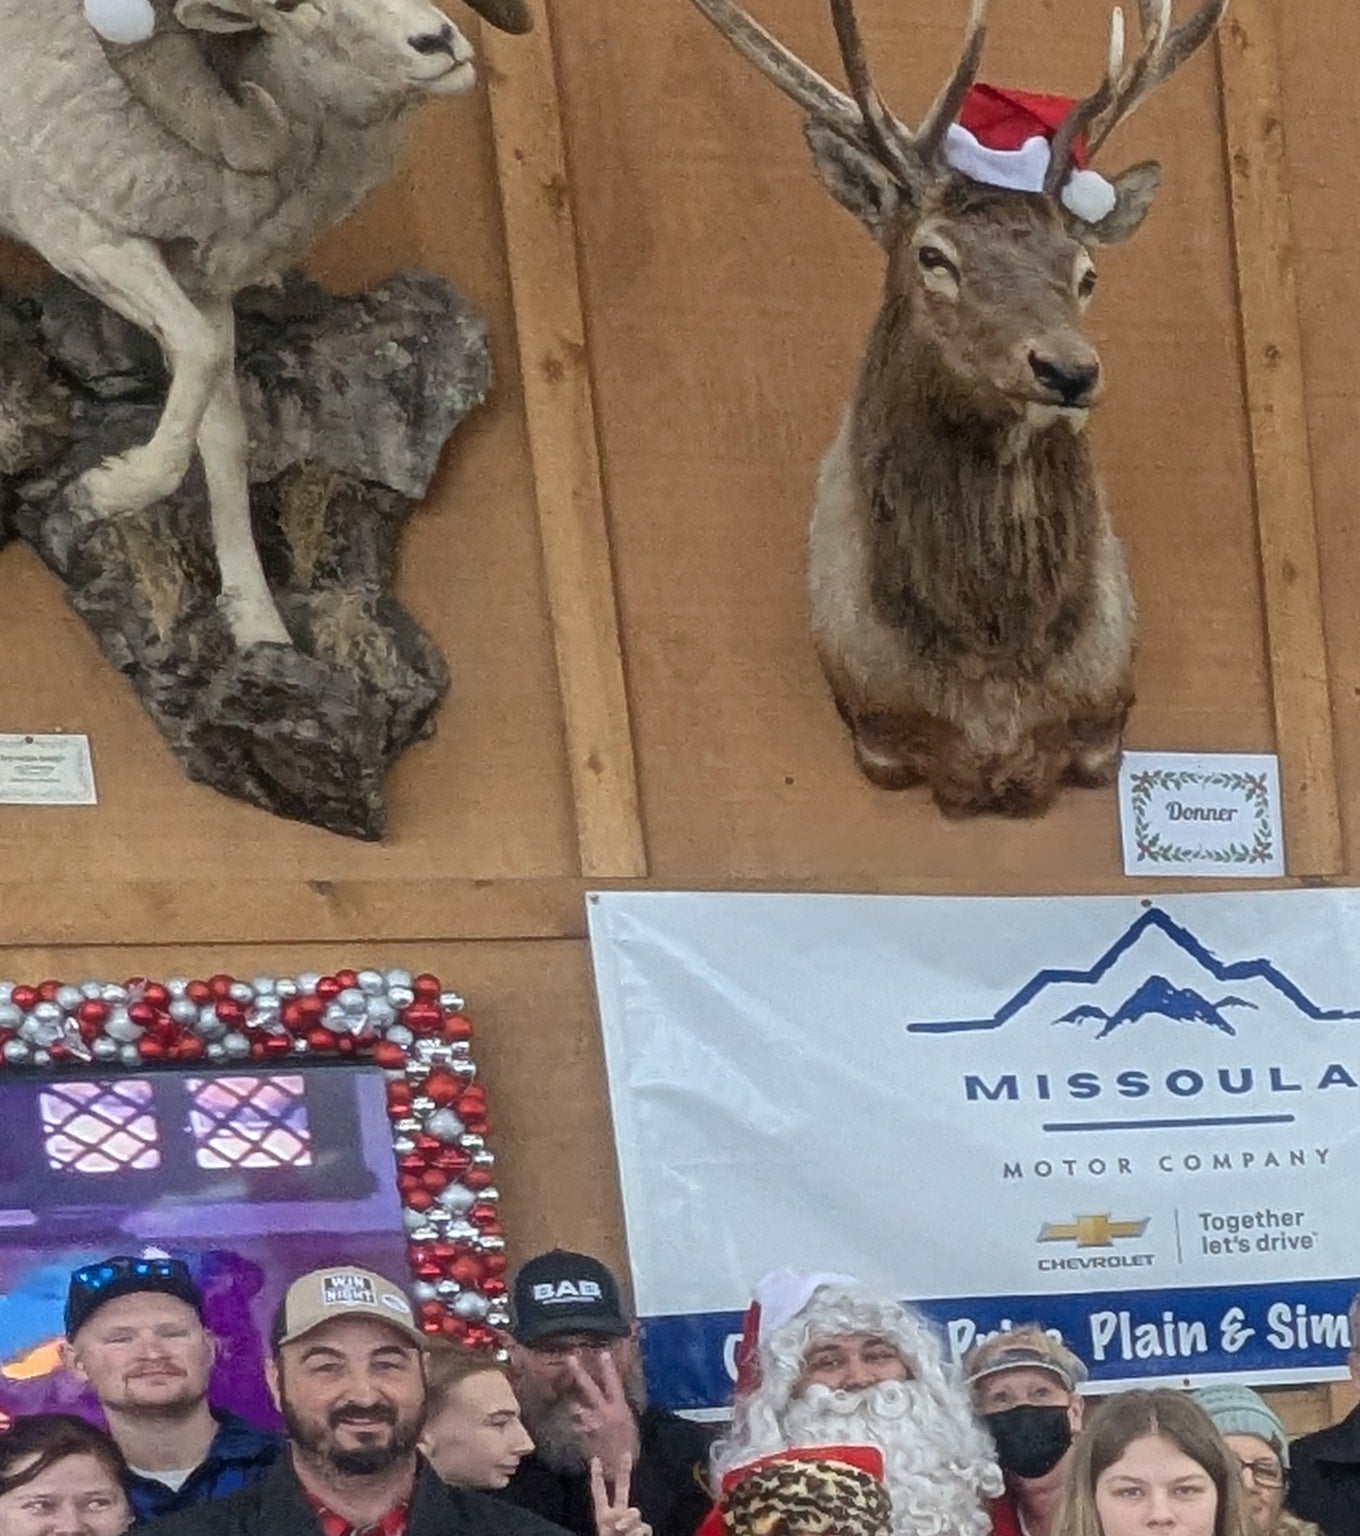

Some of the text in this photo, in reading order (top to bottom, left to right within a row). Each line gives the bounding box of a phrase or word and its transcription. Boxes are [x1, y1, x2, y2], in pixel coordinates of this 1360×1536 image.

[1165, 800, 1239, 824] Donner
[963, 1063, 1359, 1101] MISSOULA
[1002, 1147, 1331, 1180] MOTOR COMPANY
[1199, 1209, 1305, 1234] Together
[1201, 1235, 1251, 1256] let's
[1037, 1253, 1156, 1272] CHEVROLET
[1091, 1307, 1212, 1361] Plain
[1220, 1306, 1256, 1352] &
[1265, 1303, 1351, 1351] Sim
